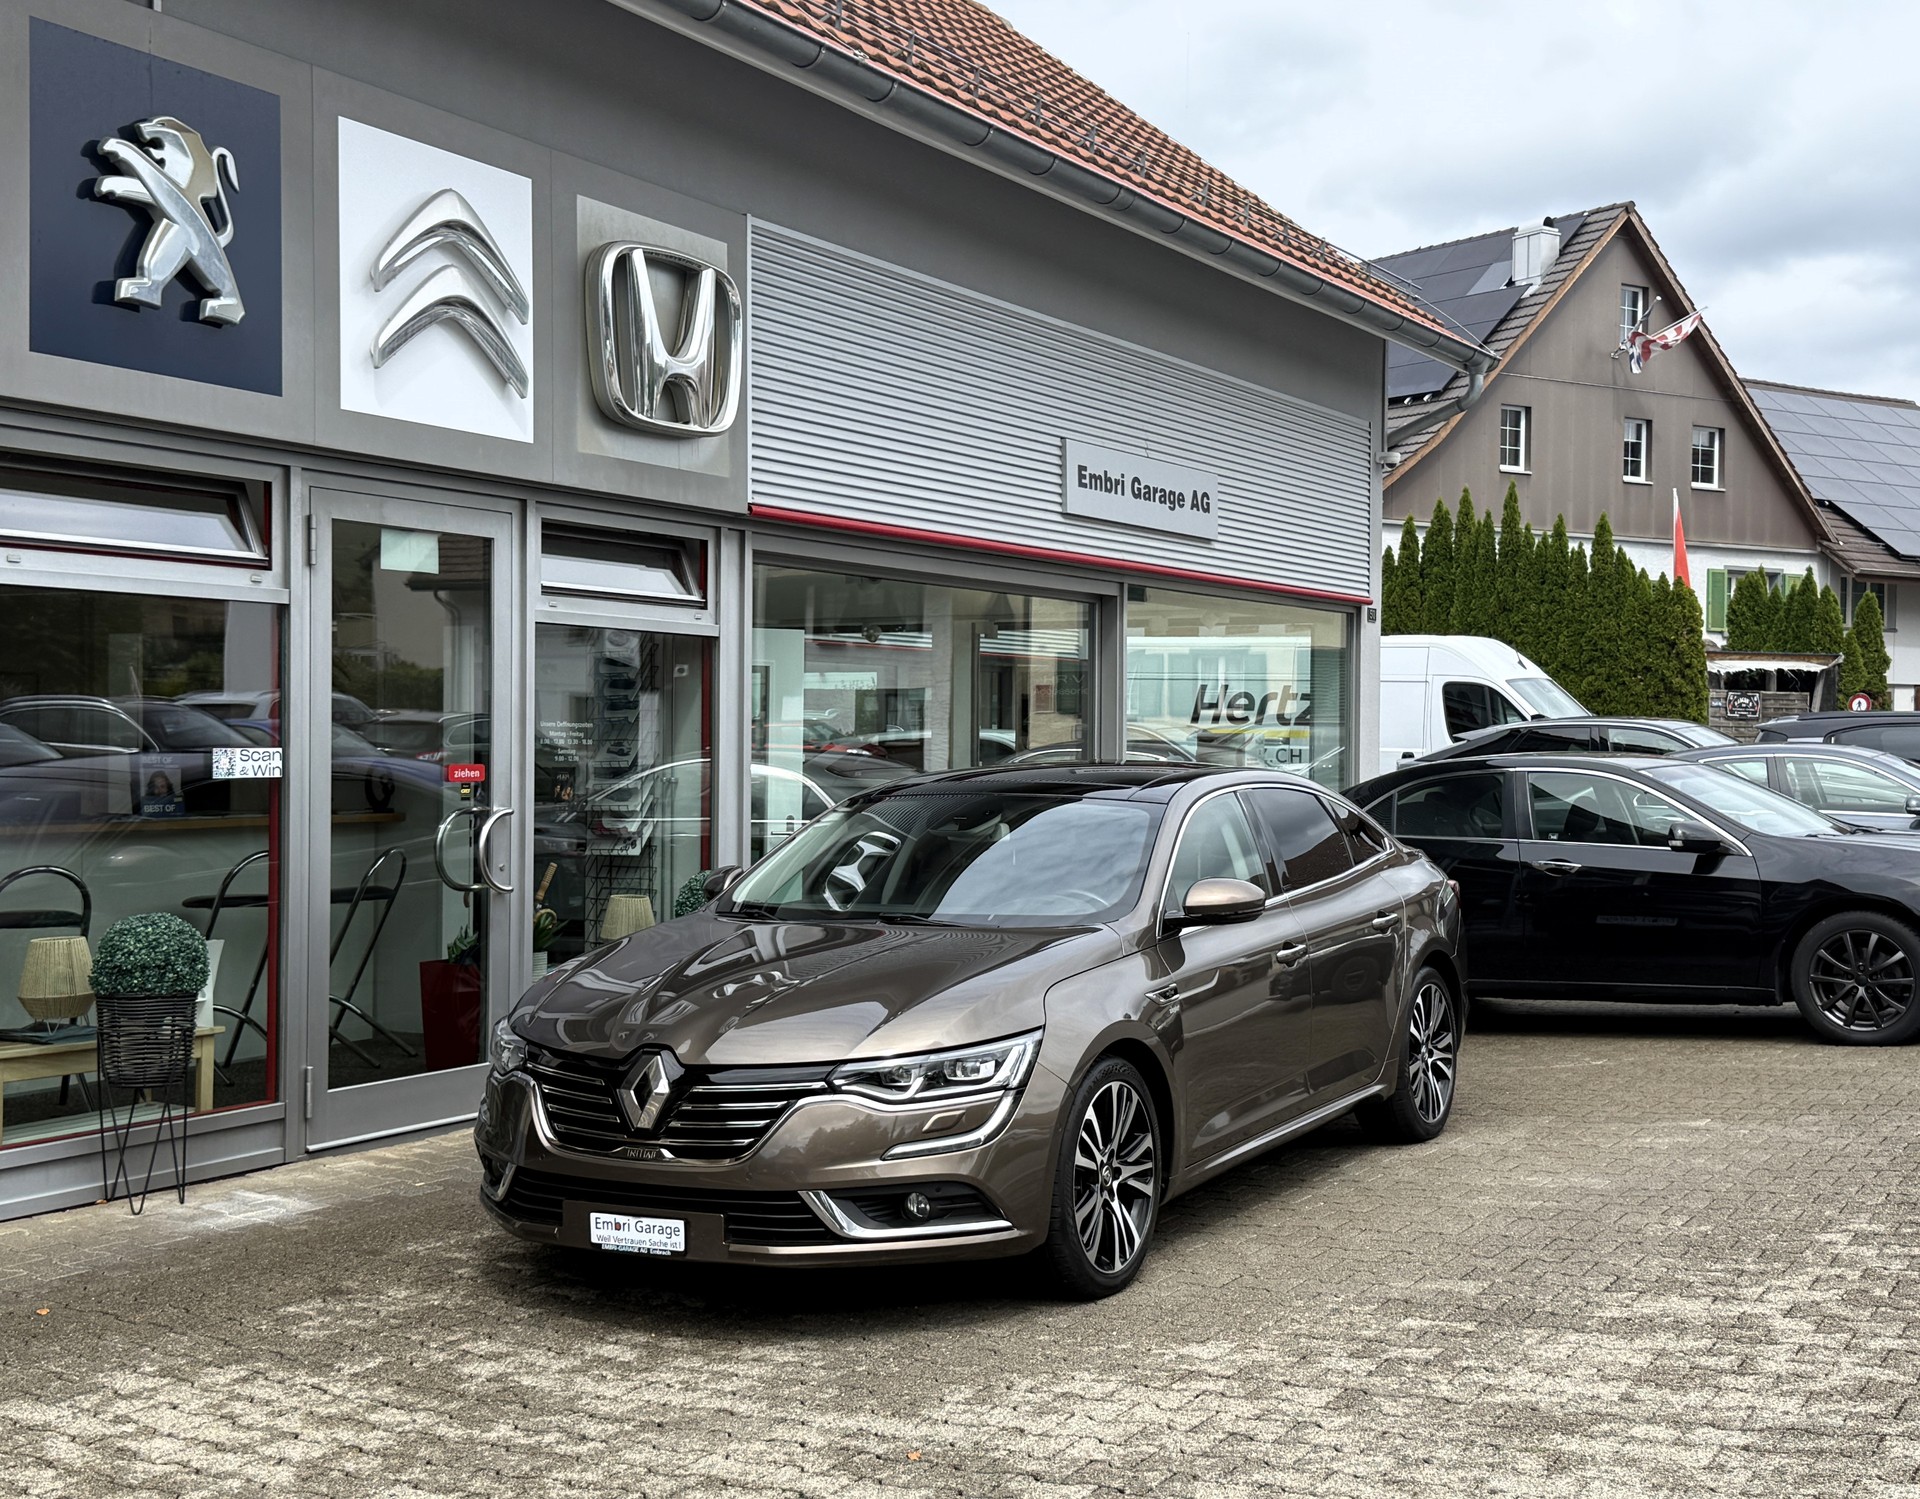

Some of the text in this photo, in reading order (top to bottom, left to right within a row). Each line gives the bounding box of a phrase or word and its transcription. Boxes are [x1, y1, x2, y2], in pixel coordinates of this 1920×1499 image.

[1077, 464, 1211, 514] Embri Garage AG
[1190, 684, 1311, 726] Hertz
[239, 749, 282, 762] Scan
[239, 762, 282, 777] & Win
[453, 768, 480, 778] ziehen
[143, 804, 176, 813] BEST OF
[595, 1217, 681, 1239] Embri Garage
[596, 1234, 611, 1243] Weil
[612, 1235, 647, 1246] Vertrauen
[648, 1239, 668, 1248] Sache
[669, 1240, 678, 1249] ist
